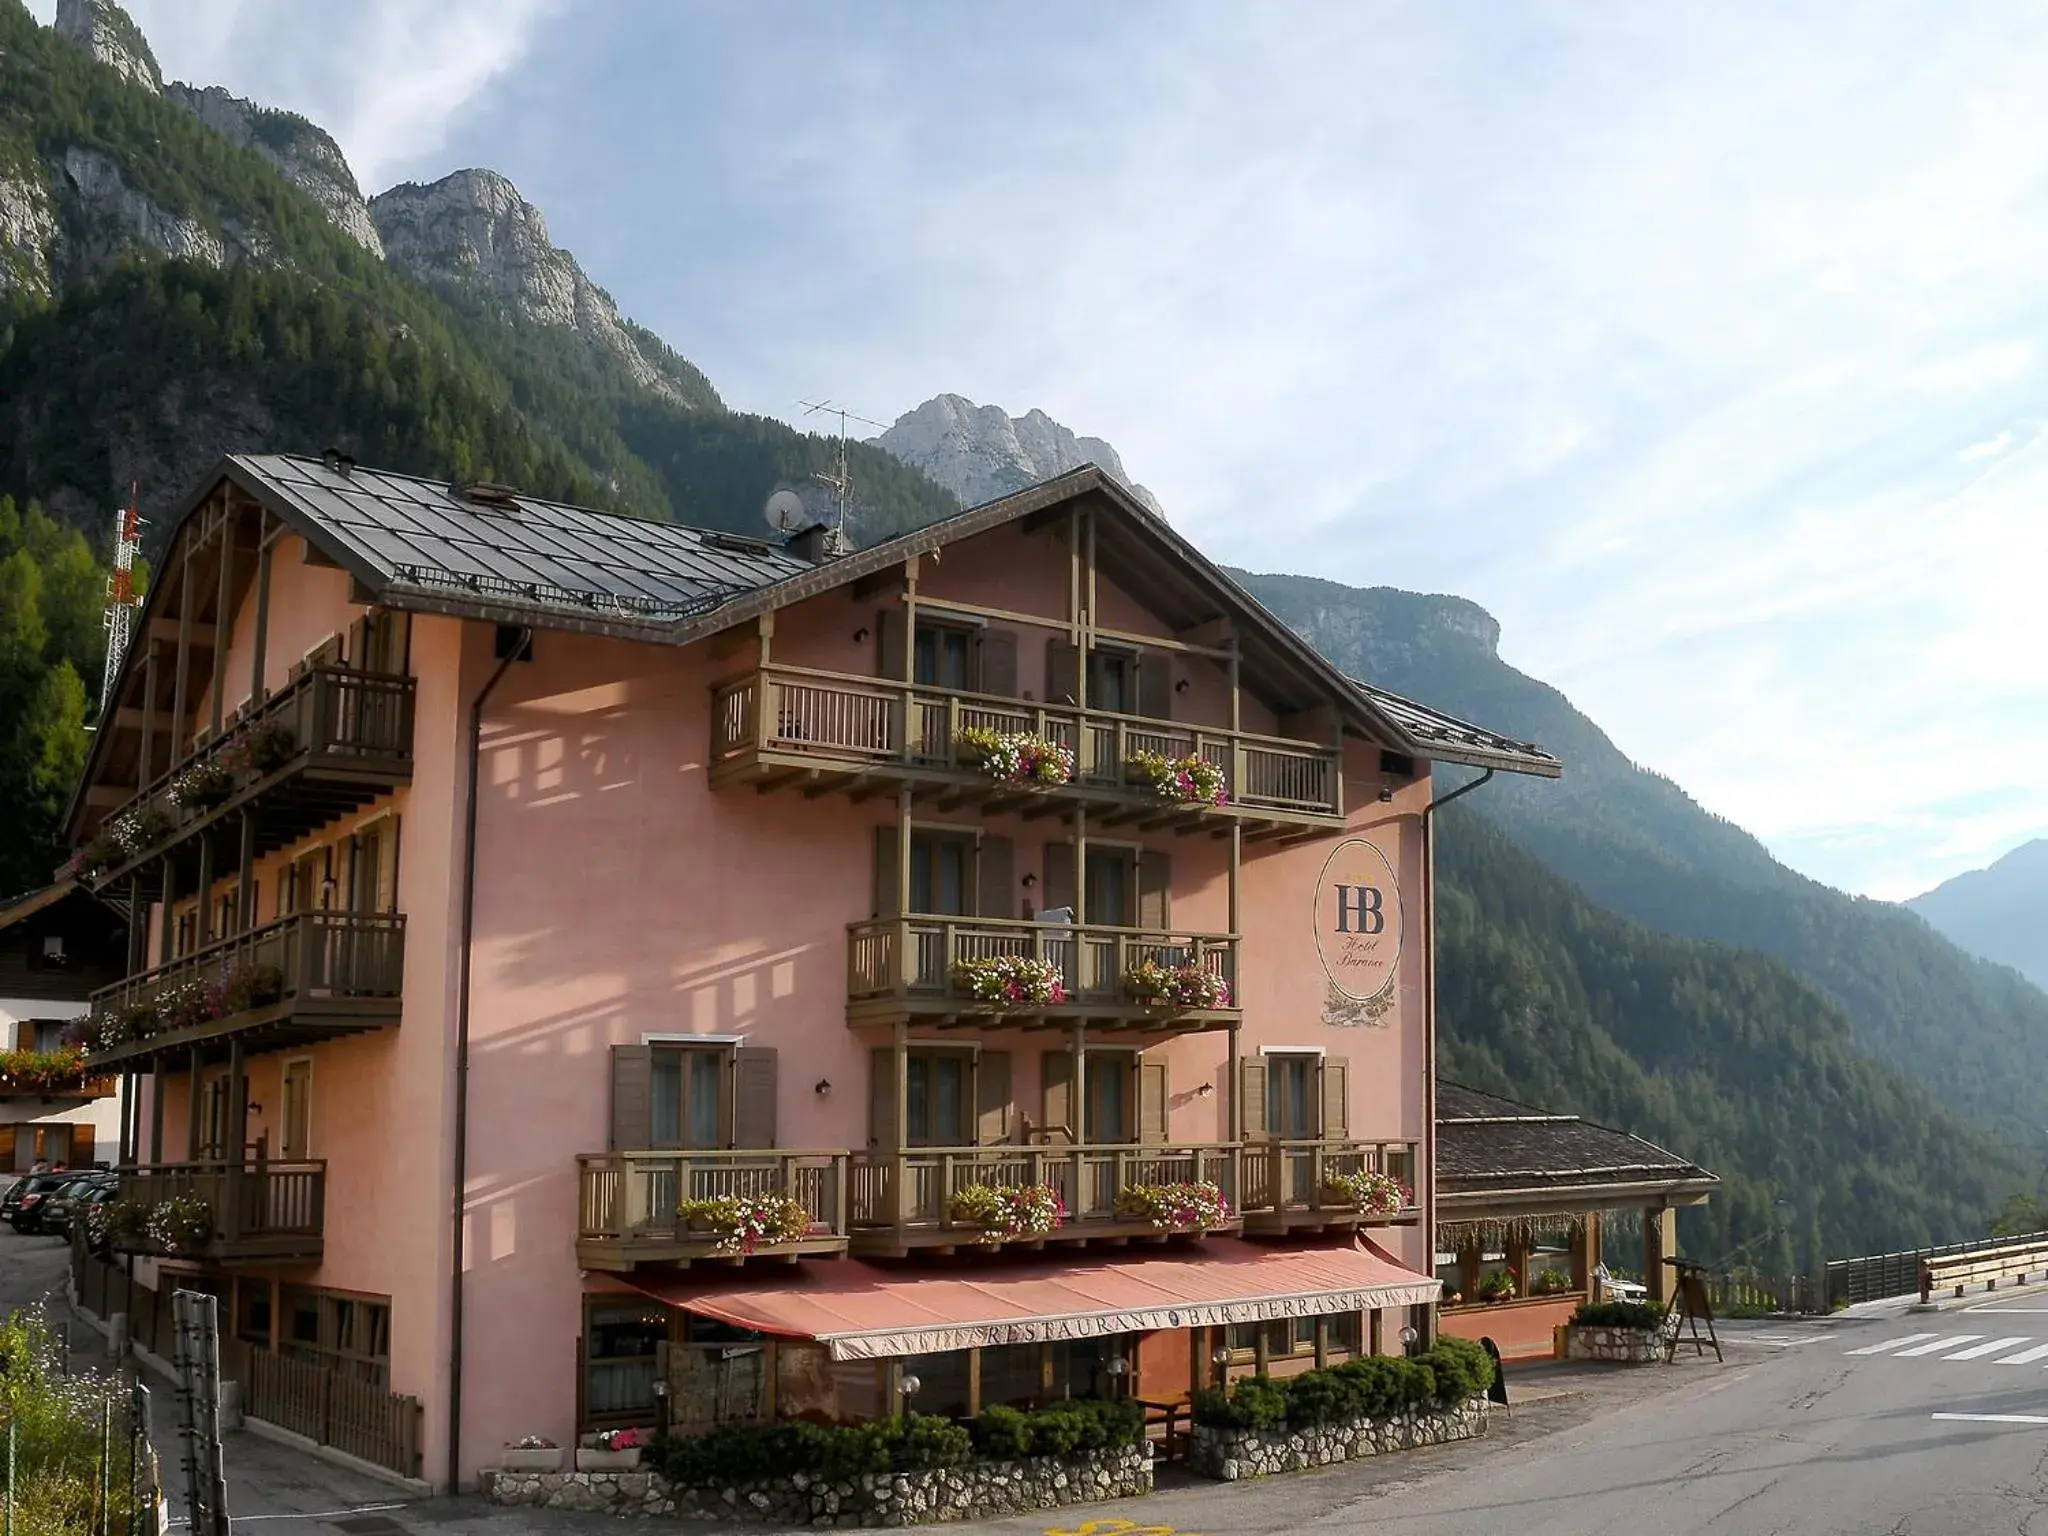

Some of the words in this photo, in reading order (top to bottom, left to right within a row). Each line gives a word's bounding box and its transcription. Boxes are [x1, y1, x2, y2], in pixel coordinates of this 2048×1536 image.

[1334, 884, 1384, 934] HB
[1342, 936, 1378, 951] Hotel
[987, 1312, 1161, 1344] RESTAURANT
[1187, 1306, 1232, 1326] BAR
[1253, 1292, 1361, 1320] TERRASSE
